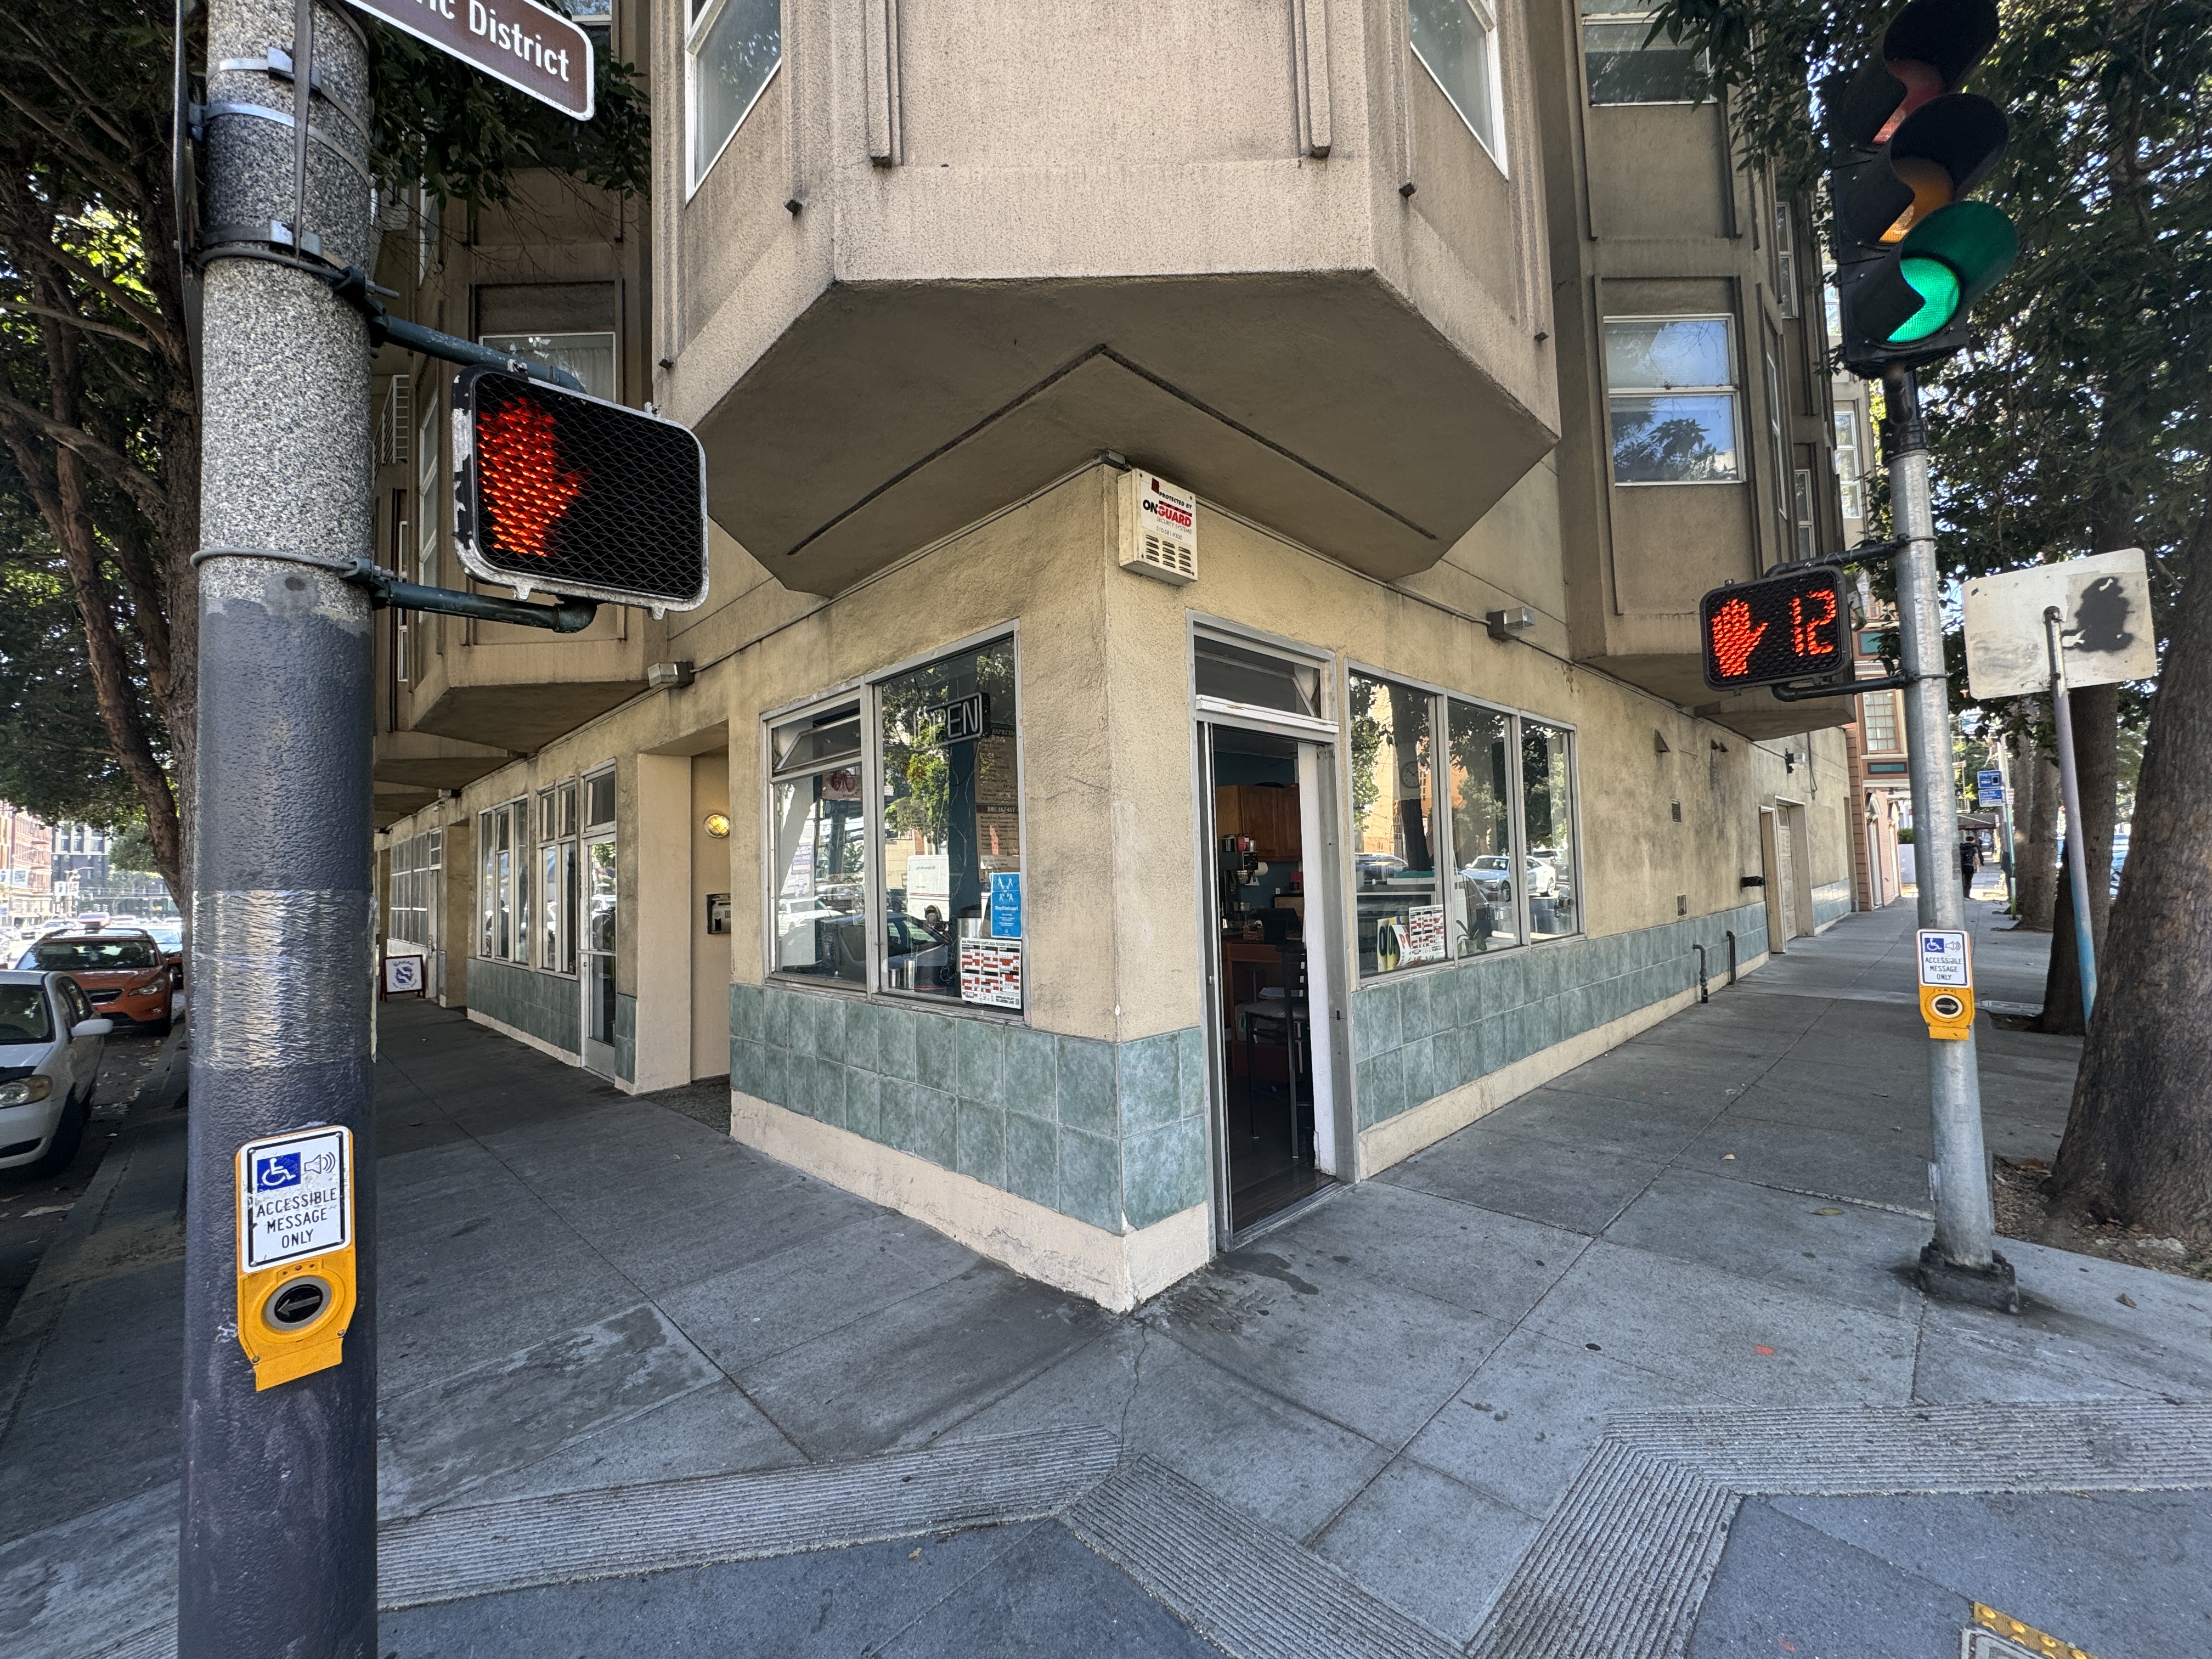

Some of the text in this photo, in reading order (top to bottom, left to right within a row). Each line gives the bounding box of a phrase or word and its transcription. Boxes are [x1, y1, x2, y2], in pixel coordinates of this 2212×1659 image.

[470, 0, 569, 82] District
[1159, 492, 1184, 506] PROTECTED
[1156, 516, 1192, 534] SECURITY SYSTEMS
[1788, 589, 1837, 657] 12
[256, 1187, 337, 1218] ACCESSIBLE
[267, 1207, 328, 1234] MESSAGE
[281, 1228, 314, 1249] ONLY
